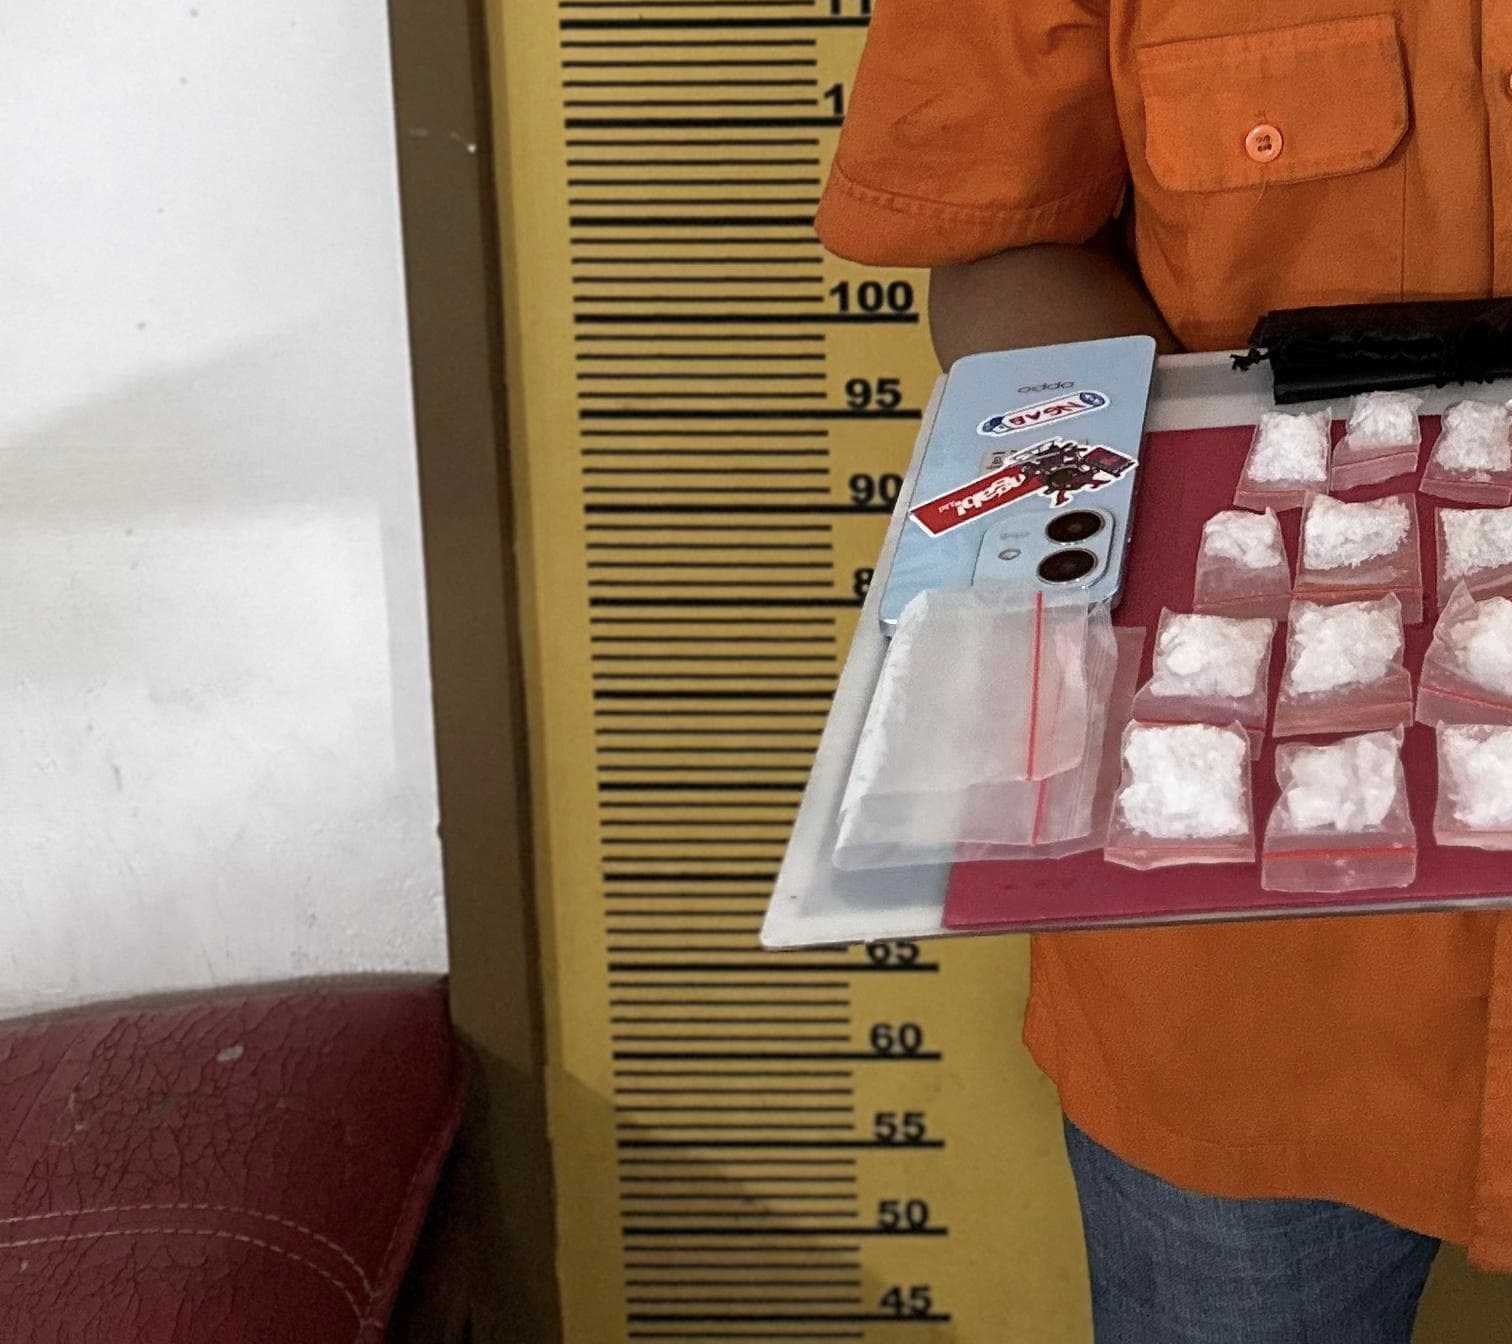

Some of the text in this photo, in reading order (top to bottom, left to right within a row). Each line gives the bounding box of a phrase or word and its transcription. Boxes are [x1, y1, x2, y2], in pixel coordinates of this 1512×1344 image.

[828, 280, 914, 313] 100
[845, 378, 902, 409] 95
[849, 473, 904, 506] 90
[853, 568, 875, 599] 8
[866, 942, 920, 966] 65
[869, 1023, 924, 1055] 60
[873, 1112, 926, 1143] 55
[876, 1200, 929, 1230] 50
[879, 1285, 932, 1316] 45
